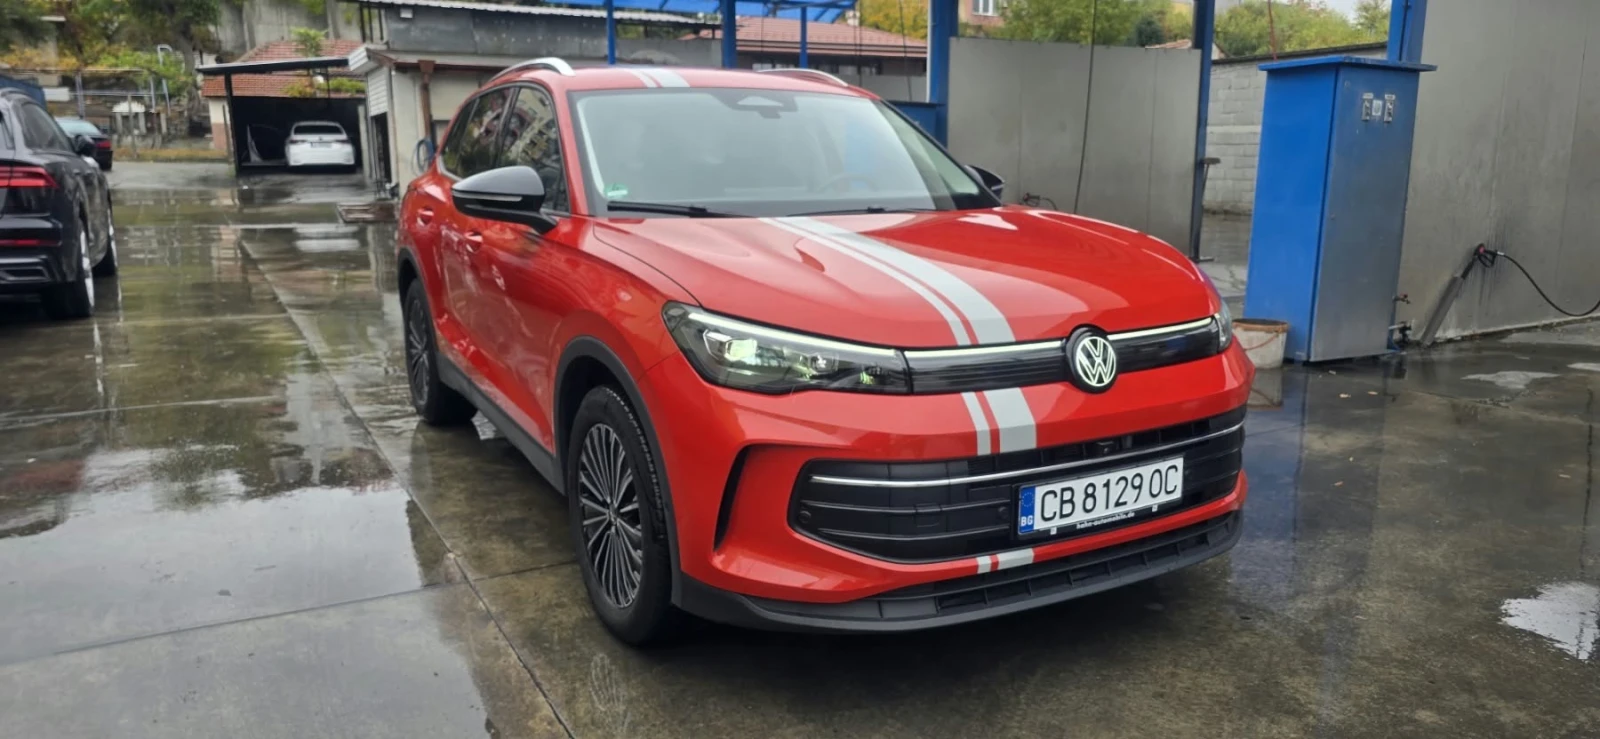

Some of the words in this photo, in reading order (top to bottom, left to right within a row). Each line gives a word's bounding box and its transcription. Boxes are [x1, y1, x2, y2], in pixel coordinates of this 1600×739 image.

[1040, 486, 1076, 522] CB
[1082, 472, 1144, 513] 8129
[1149, 464, 1179, 498] OC
[1020, 515, 1034, 527] BG
